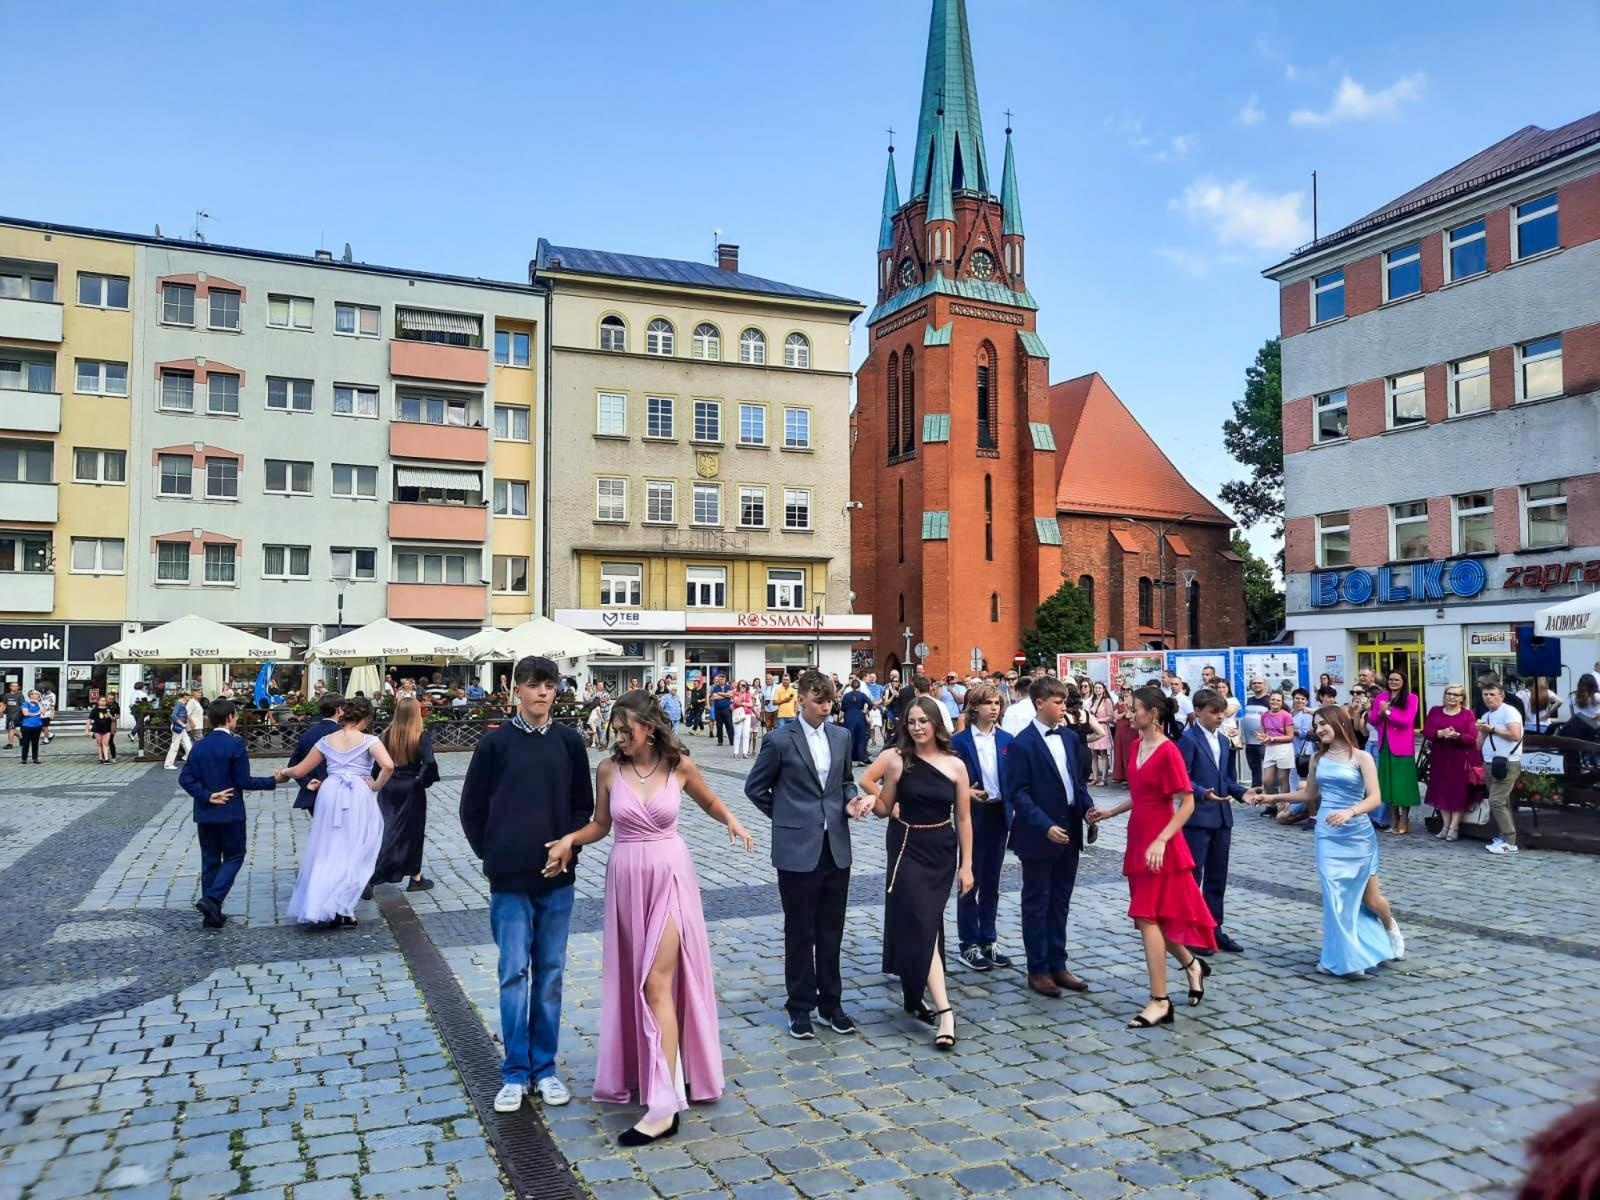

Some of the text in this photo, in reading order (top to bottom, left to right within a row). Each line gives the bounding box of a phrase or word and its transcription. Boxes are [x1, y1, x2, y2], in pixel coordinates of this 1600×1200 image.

[1311, 559, 1600, 607] BOLKO zapra
[620, 612, 640, 620] TEB
[738, 613, 824, 627] ROSSMANN
[0, 632, 61, 652] empik
[128, 648, 160, 657] Kozel
[190, 647, 220, 657] Kozel
[248, 648, 277, 657] Kozel
